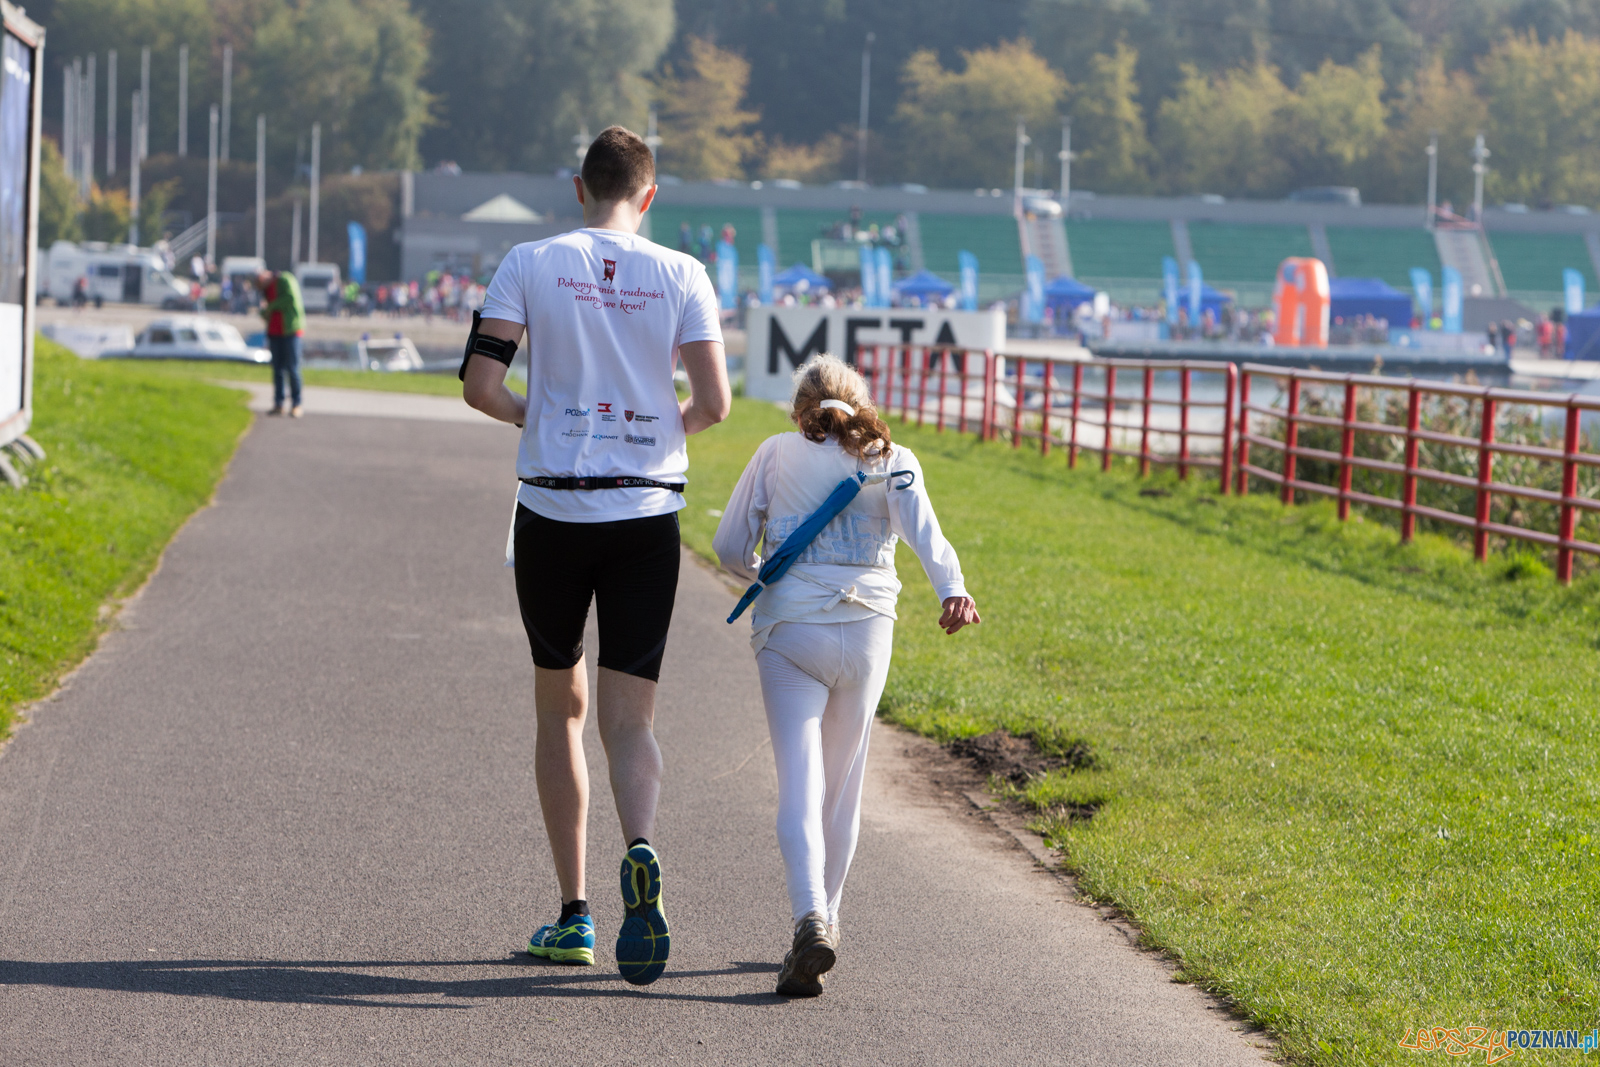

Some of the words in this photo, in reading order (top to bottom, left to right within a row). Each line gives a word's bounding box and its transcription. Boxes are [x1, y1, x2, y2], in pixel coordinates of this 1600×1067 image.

[619, 287, 665, 299] trudności
[619, 299, 647, 315] krwi!
[767, 313, 964, 378] META
